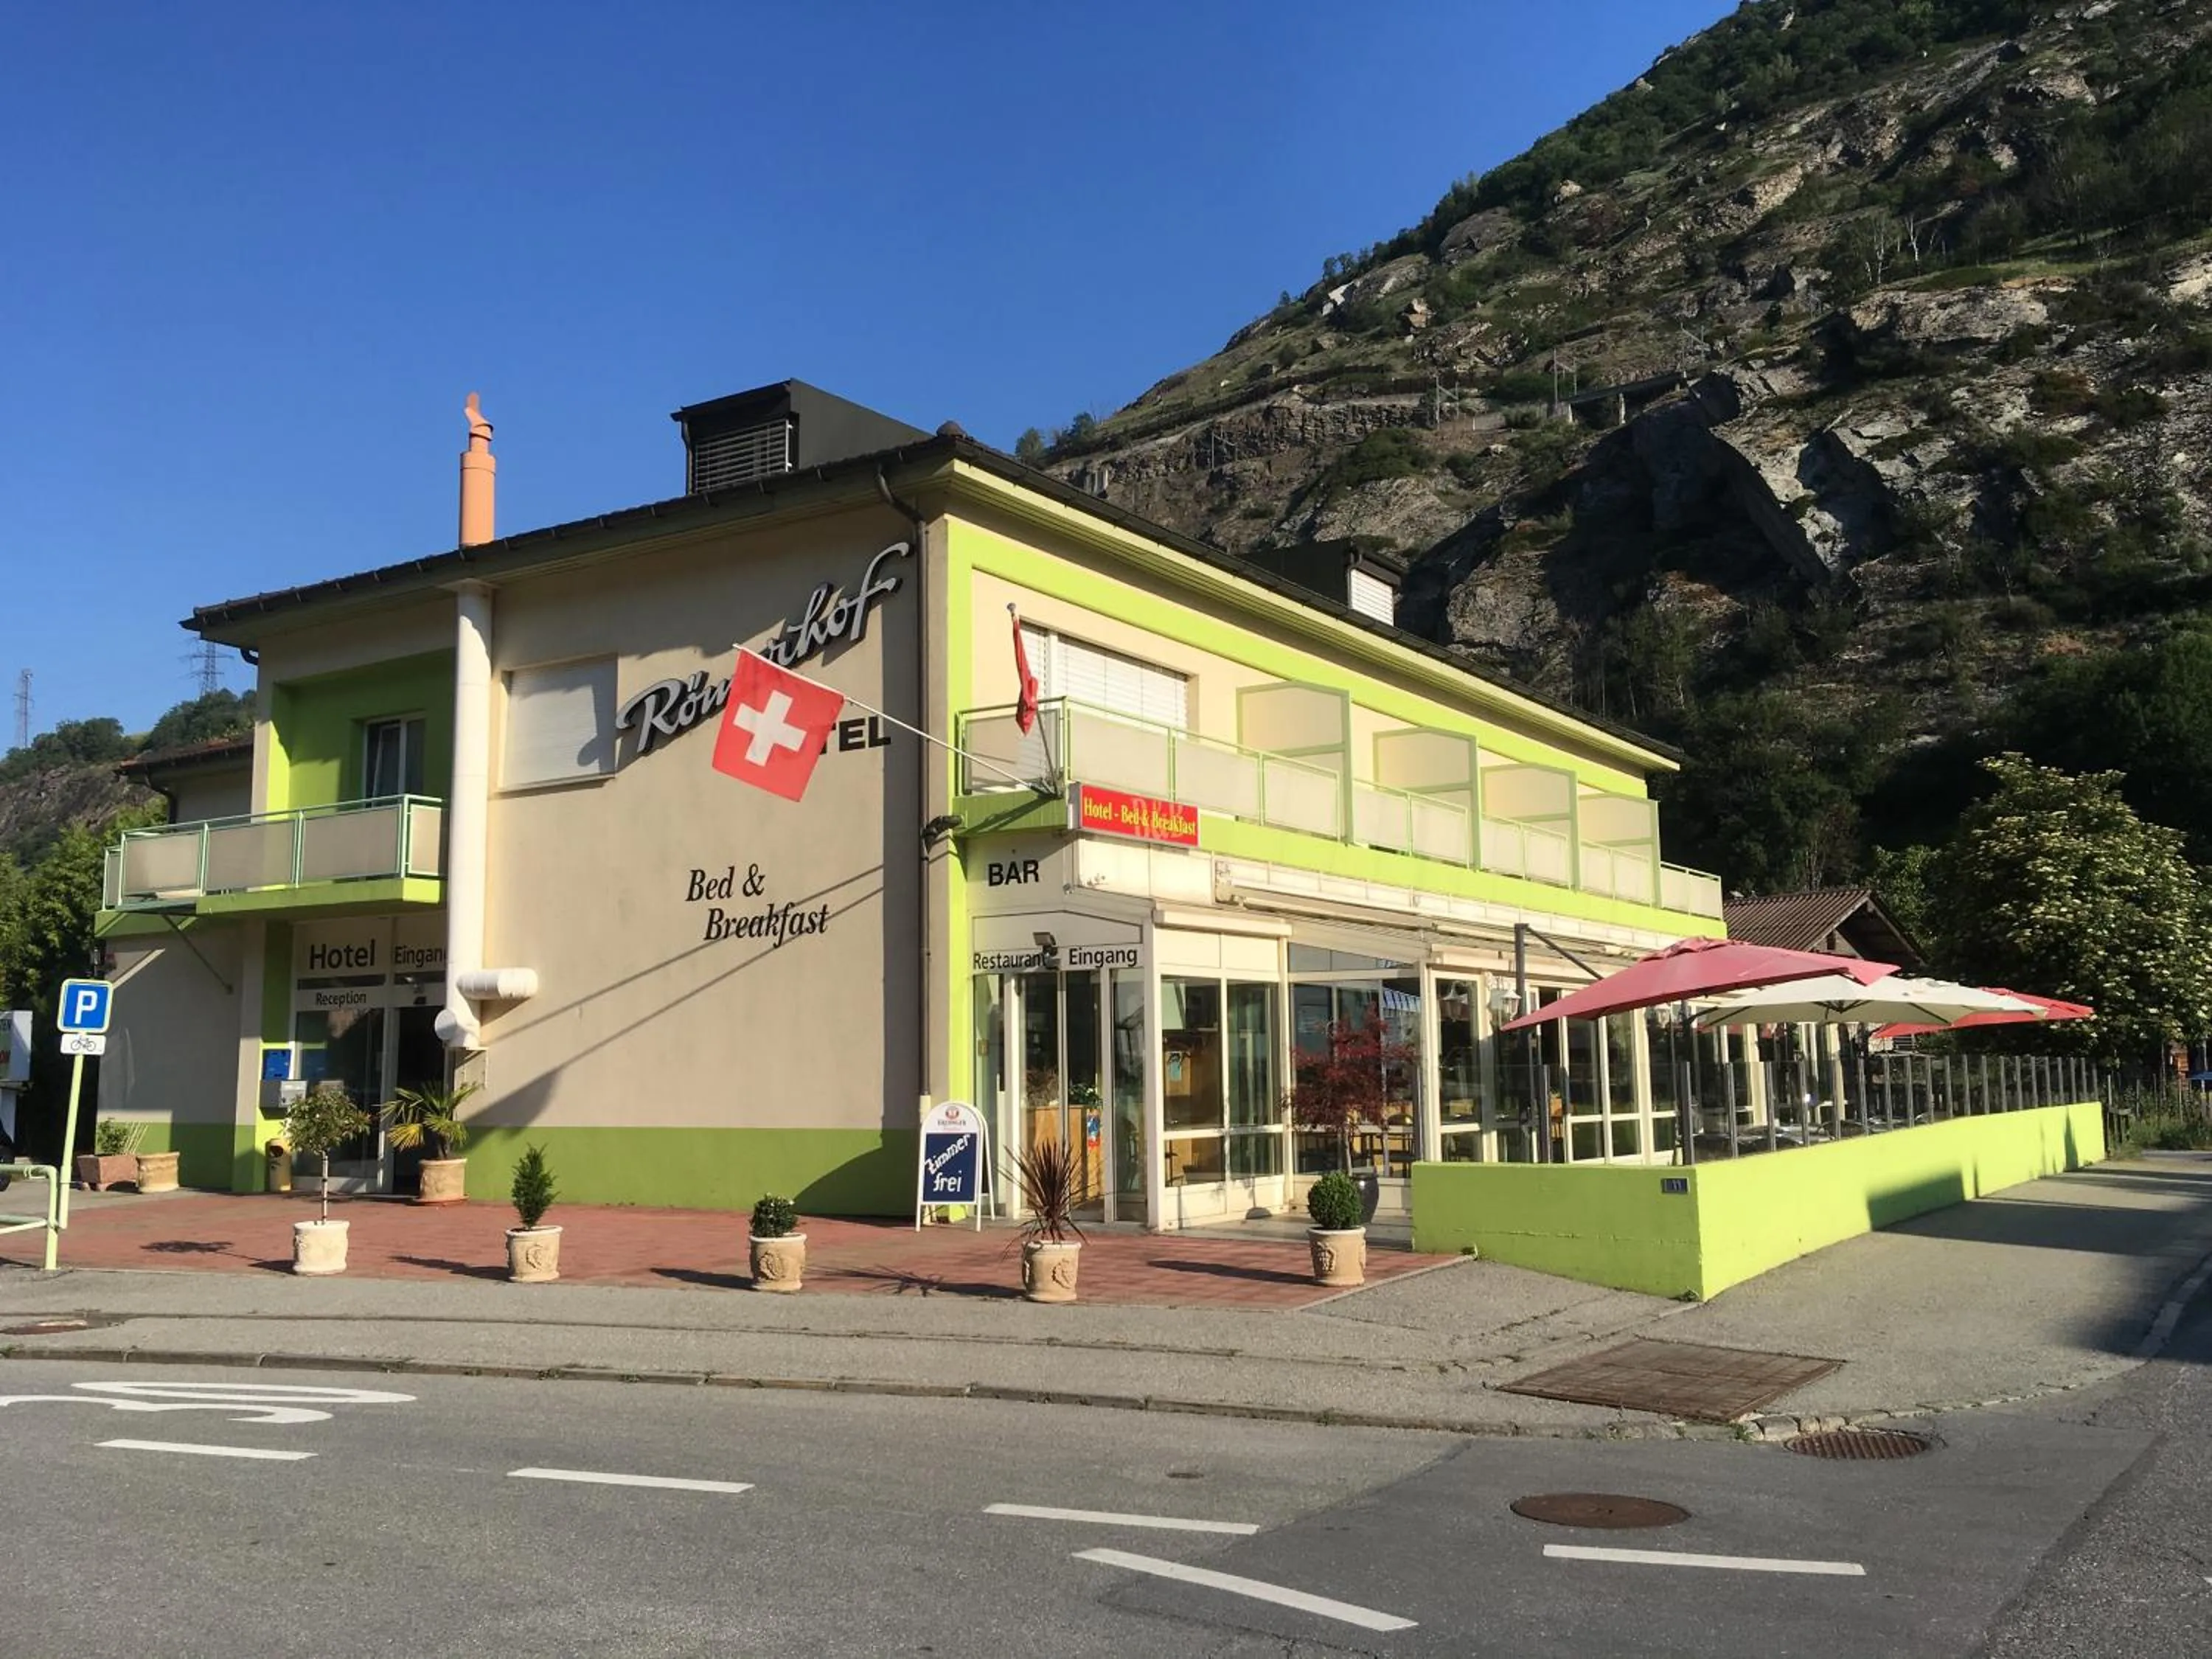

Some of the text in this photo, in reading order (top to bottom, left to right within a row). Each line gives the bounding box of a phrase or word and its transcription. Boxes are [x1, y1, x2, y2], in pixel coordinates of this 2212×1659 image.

[616, 541, 913, 753] Römrhof
[1083, 796, 1112, 821] Hotel
[1121, 804, 1139, 825] Bed
[1141, 810, 1150, 827] &
[1152, 811, 1196, 835] Breakfast
[685, 863, 766, 902] Bed &
[988, 859, 1040, 887] BAR
[703, 902, 830, 949] Breakfast
[309, 939, 376, 970] Hotel
[1069, 947, 1138, 968] Eingang
[74, 990, 98, 1025] P
[316, 991, 367, 1008] Reception
[925, 1133, 971, 1175] Zimmer
[933, 1171, 963, 1192] frei
